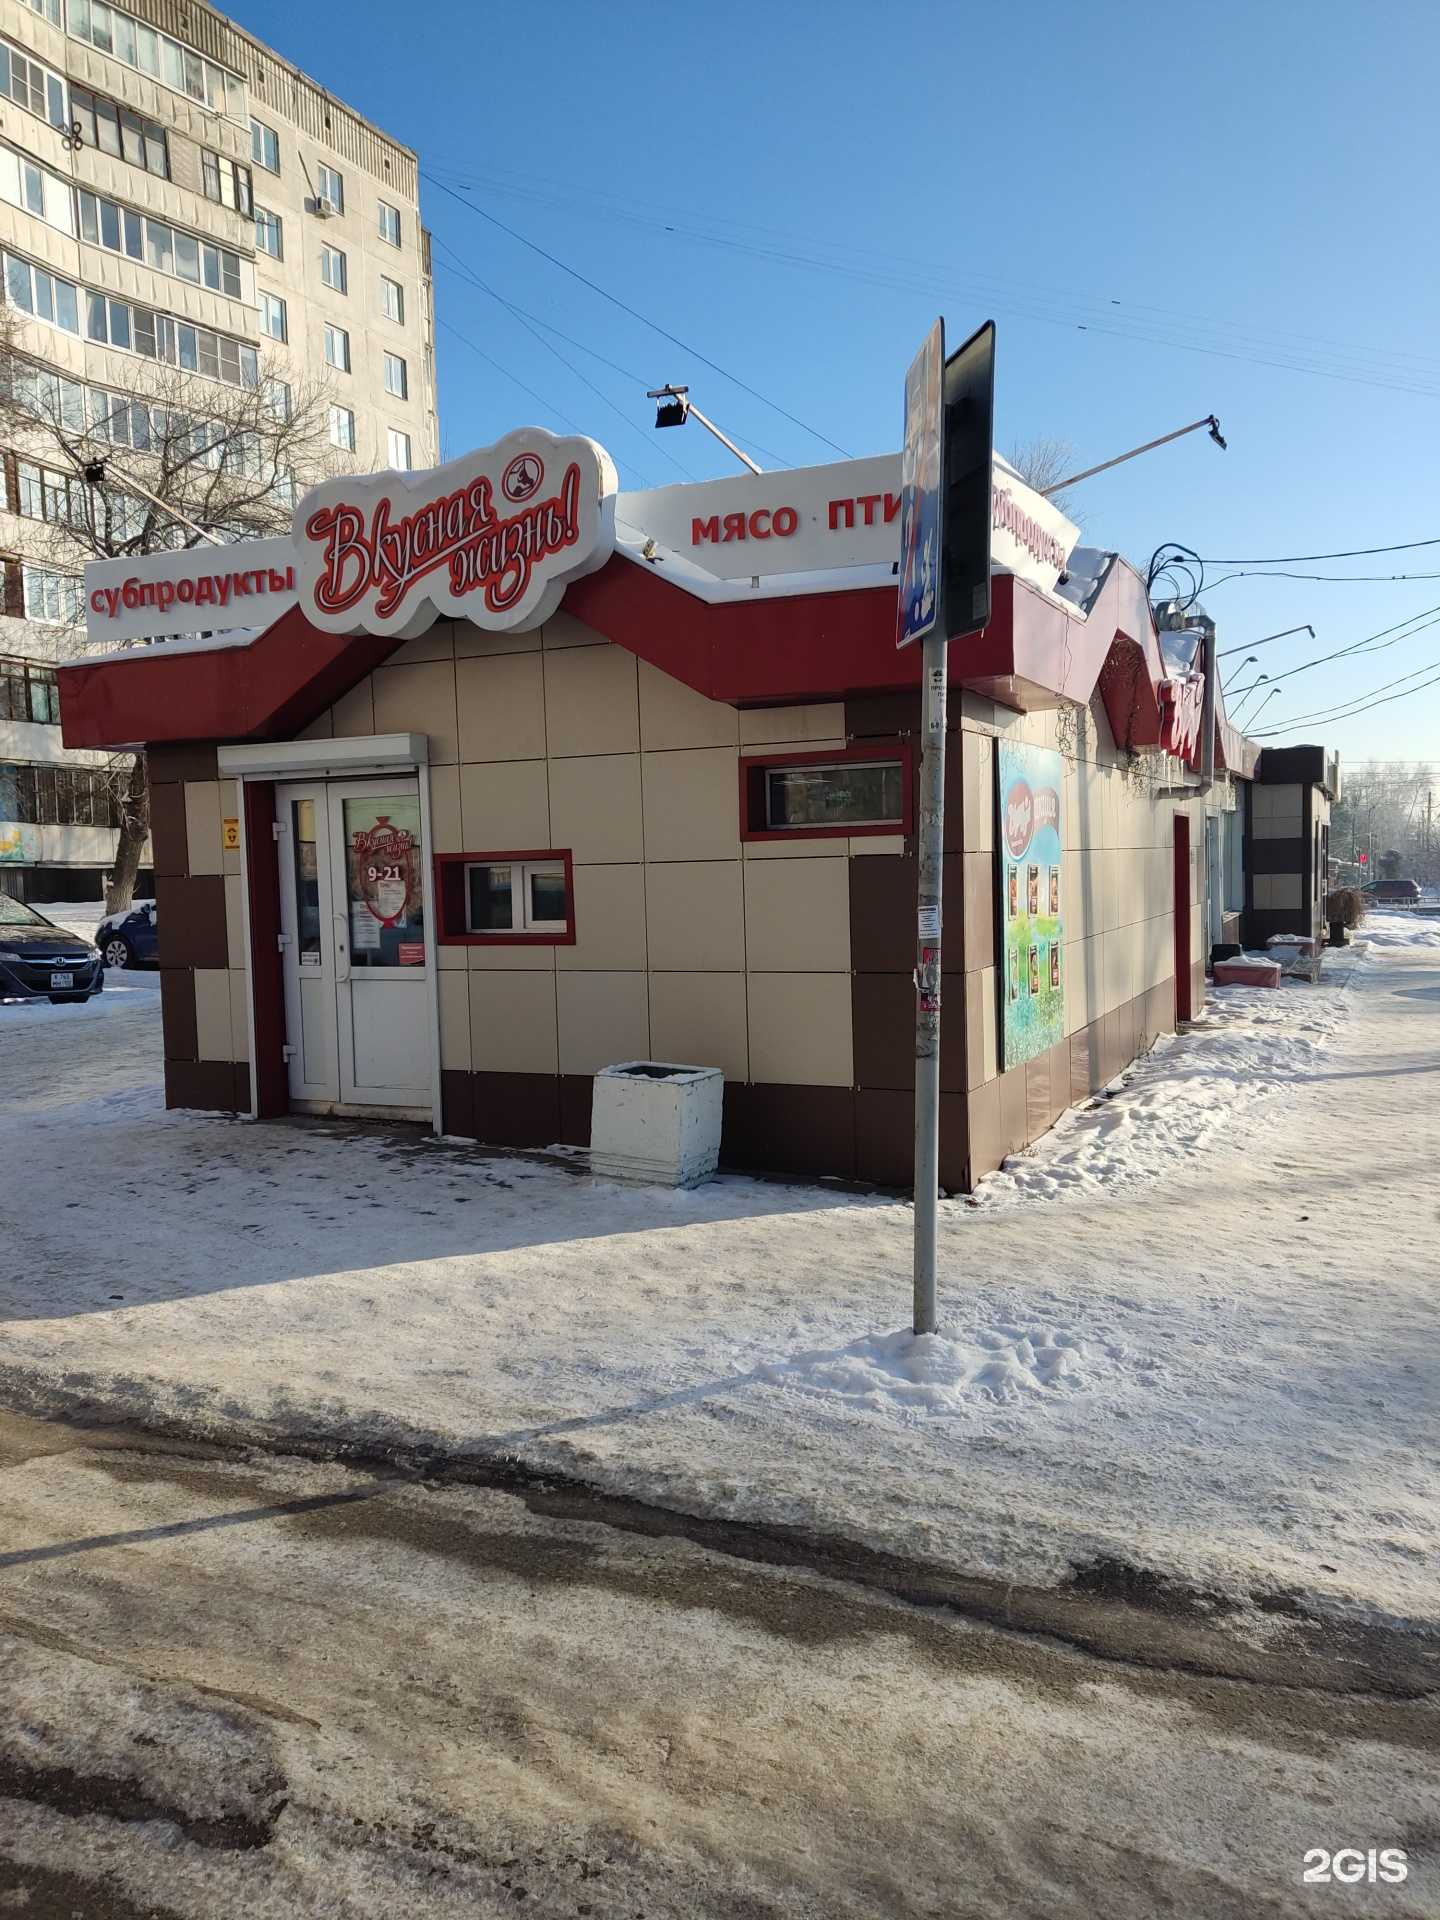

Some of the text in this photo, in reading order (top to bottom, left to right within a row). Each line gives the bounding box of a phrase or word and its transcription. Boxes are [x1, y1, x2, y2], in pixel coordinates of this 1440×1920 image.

[451, 459, 579, 611] жизнь!
[828, 493, 901, 530] пти
[307, 477, 496, 617] Вкусная
[90, 566, 296, 618] субпродукты
[367, 866, 401, 882] 9-21
